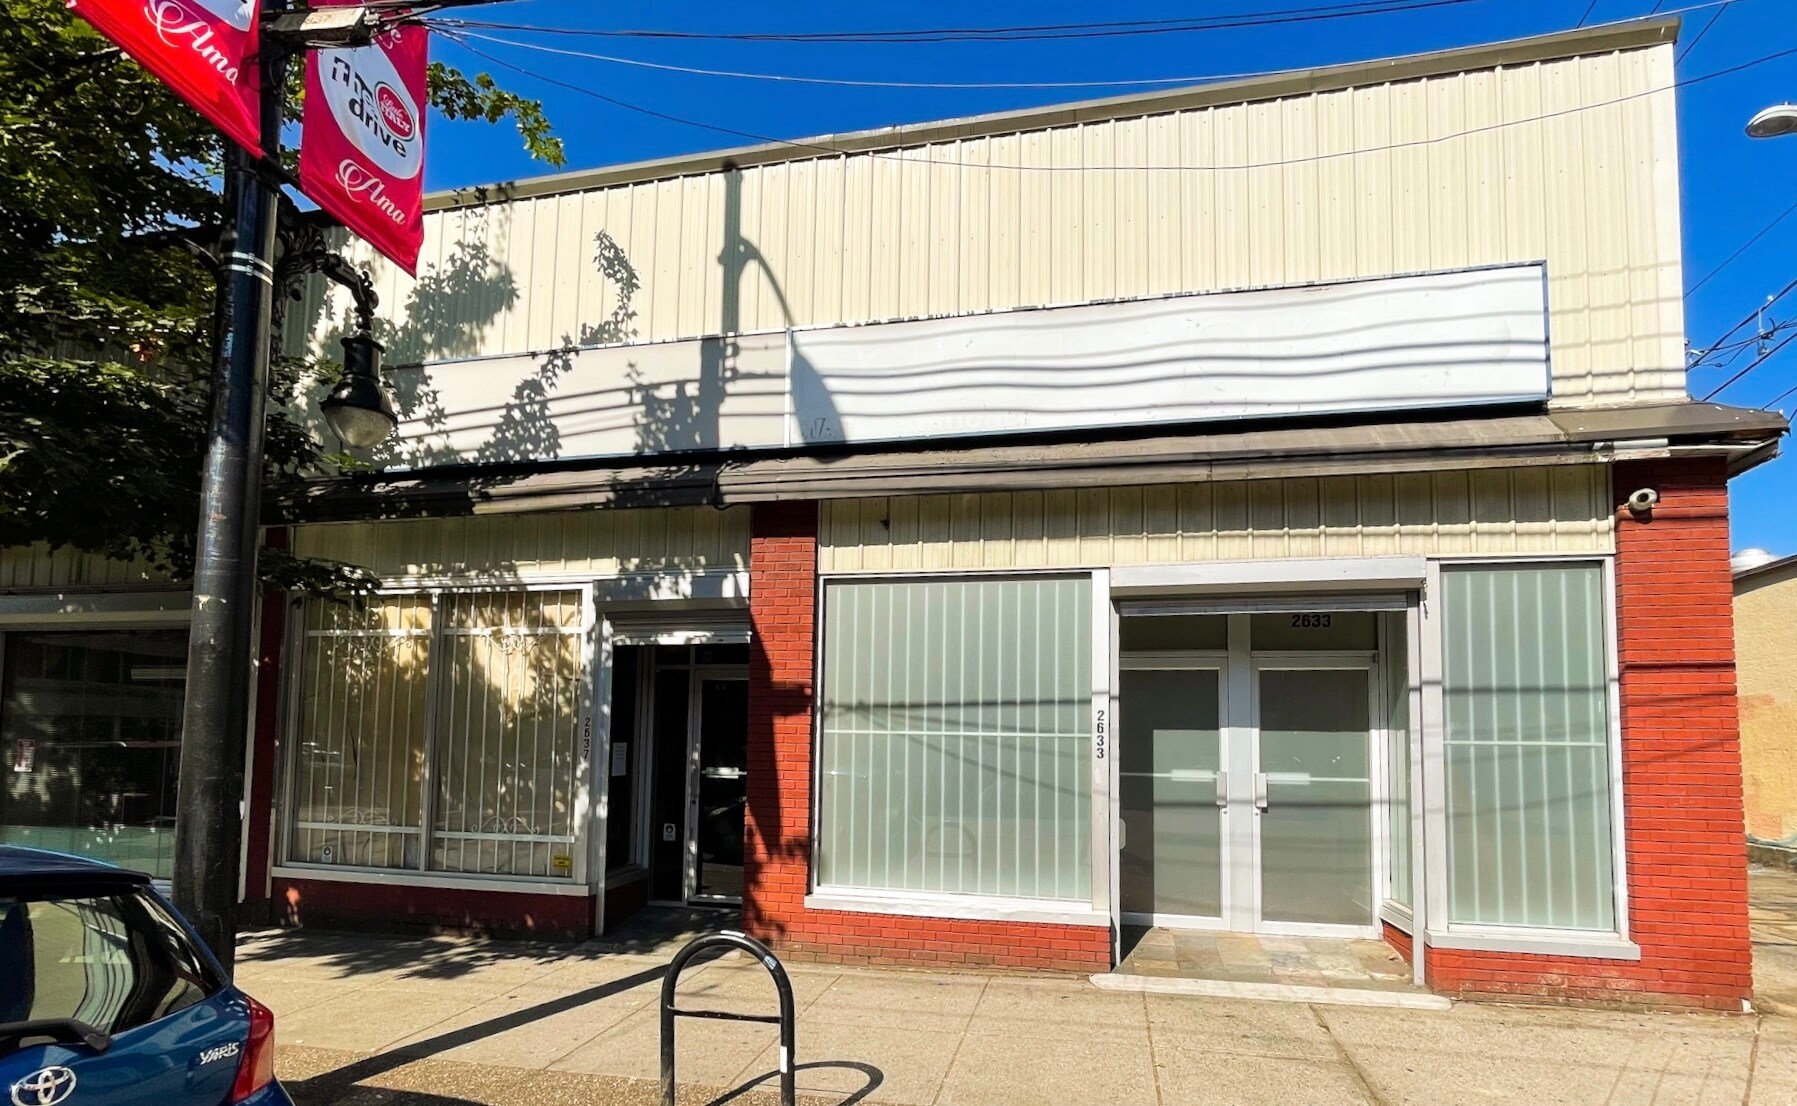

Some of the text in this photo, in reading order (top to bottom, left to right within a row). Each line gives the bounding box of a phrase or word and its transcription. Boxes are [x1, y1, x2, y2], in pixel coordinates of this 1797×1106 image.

[144, 0, 238, 86] Ama
[349, 97, 407, 158] drive
[335, 159, 406, 225] Ama
[1291, 614, 1331, 628] 2633
[583, 717, 591, 760] 2637
[1096, 709, 1105, 760] 2633
[200, 1042, 239, 1065] YARIS
